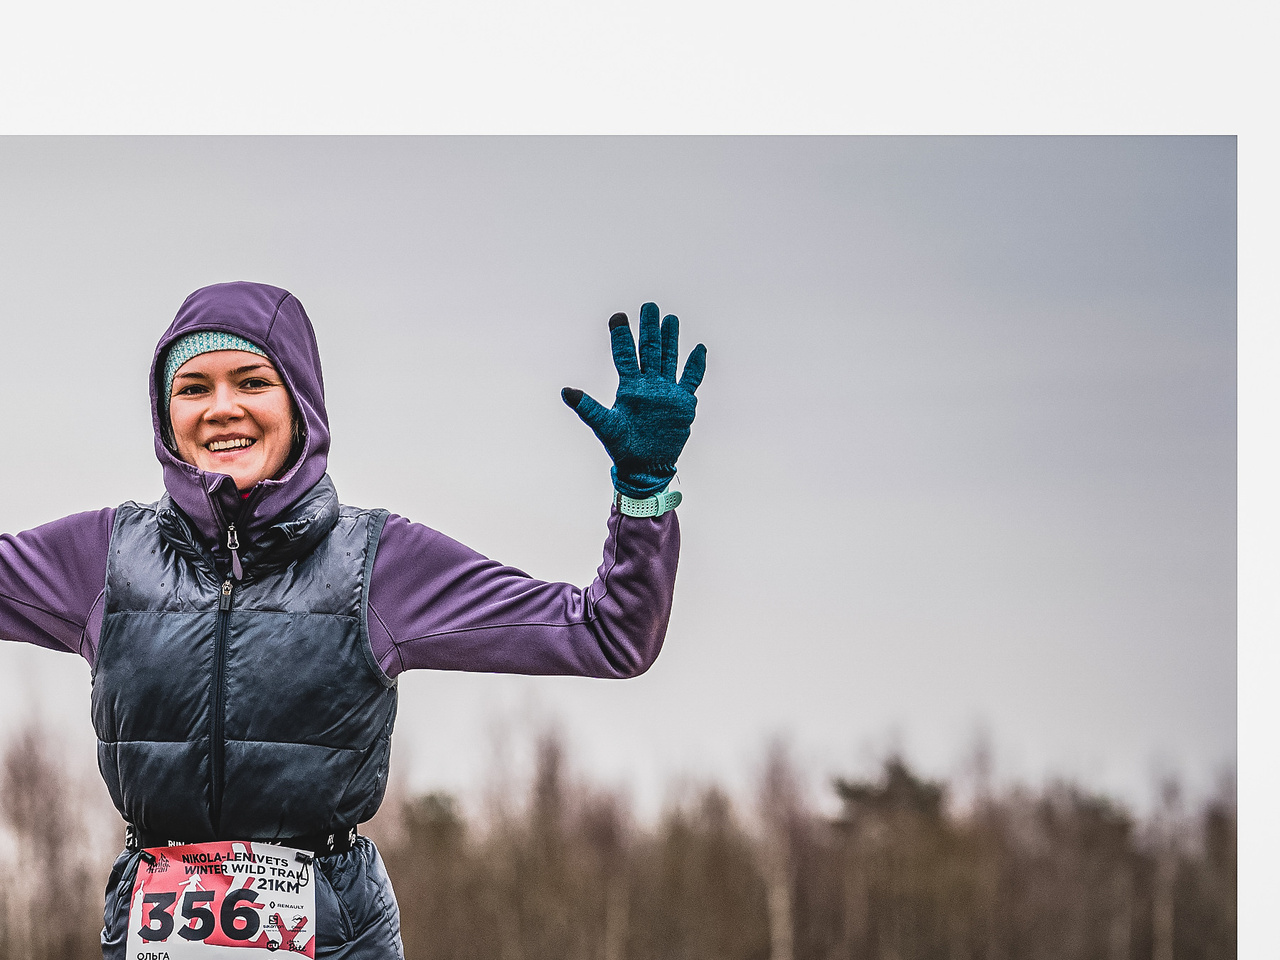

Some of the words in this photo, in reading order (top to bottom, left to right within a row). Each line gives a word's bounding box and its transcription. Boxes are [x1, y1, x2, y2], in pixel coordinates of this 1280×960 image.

[182, 852, 289, 867] NIKOLA-LENIVETS
[185, 865, 228, 875] WINTER
[232, 864, 266, 875] WILD
[257, 877, 300, 894] 21KM
[137, 889, 261, 942] 356
[136, 951, 170, 960] ОЛЬГА
